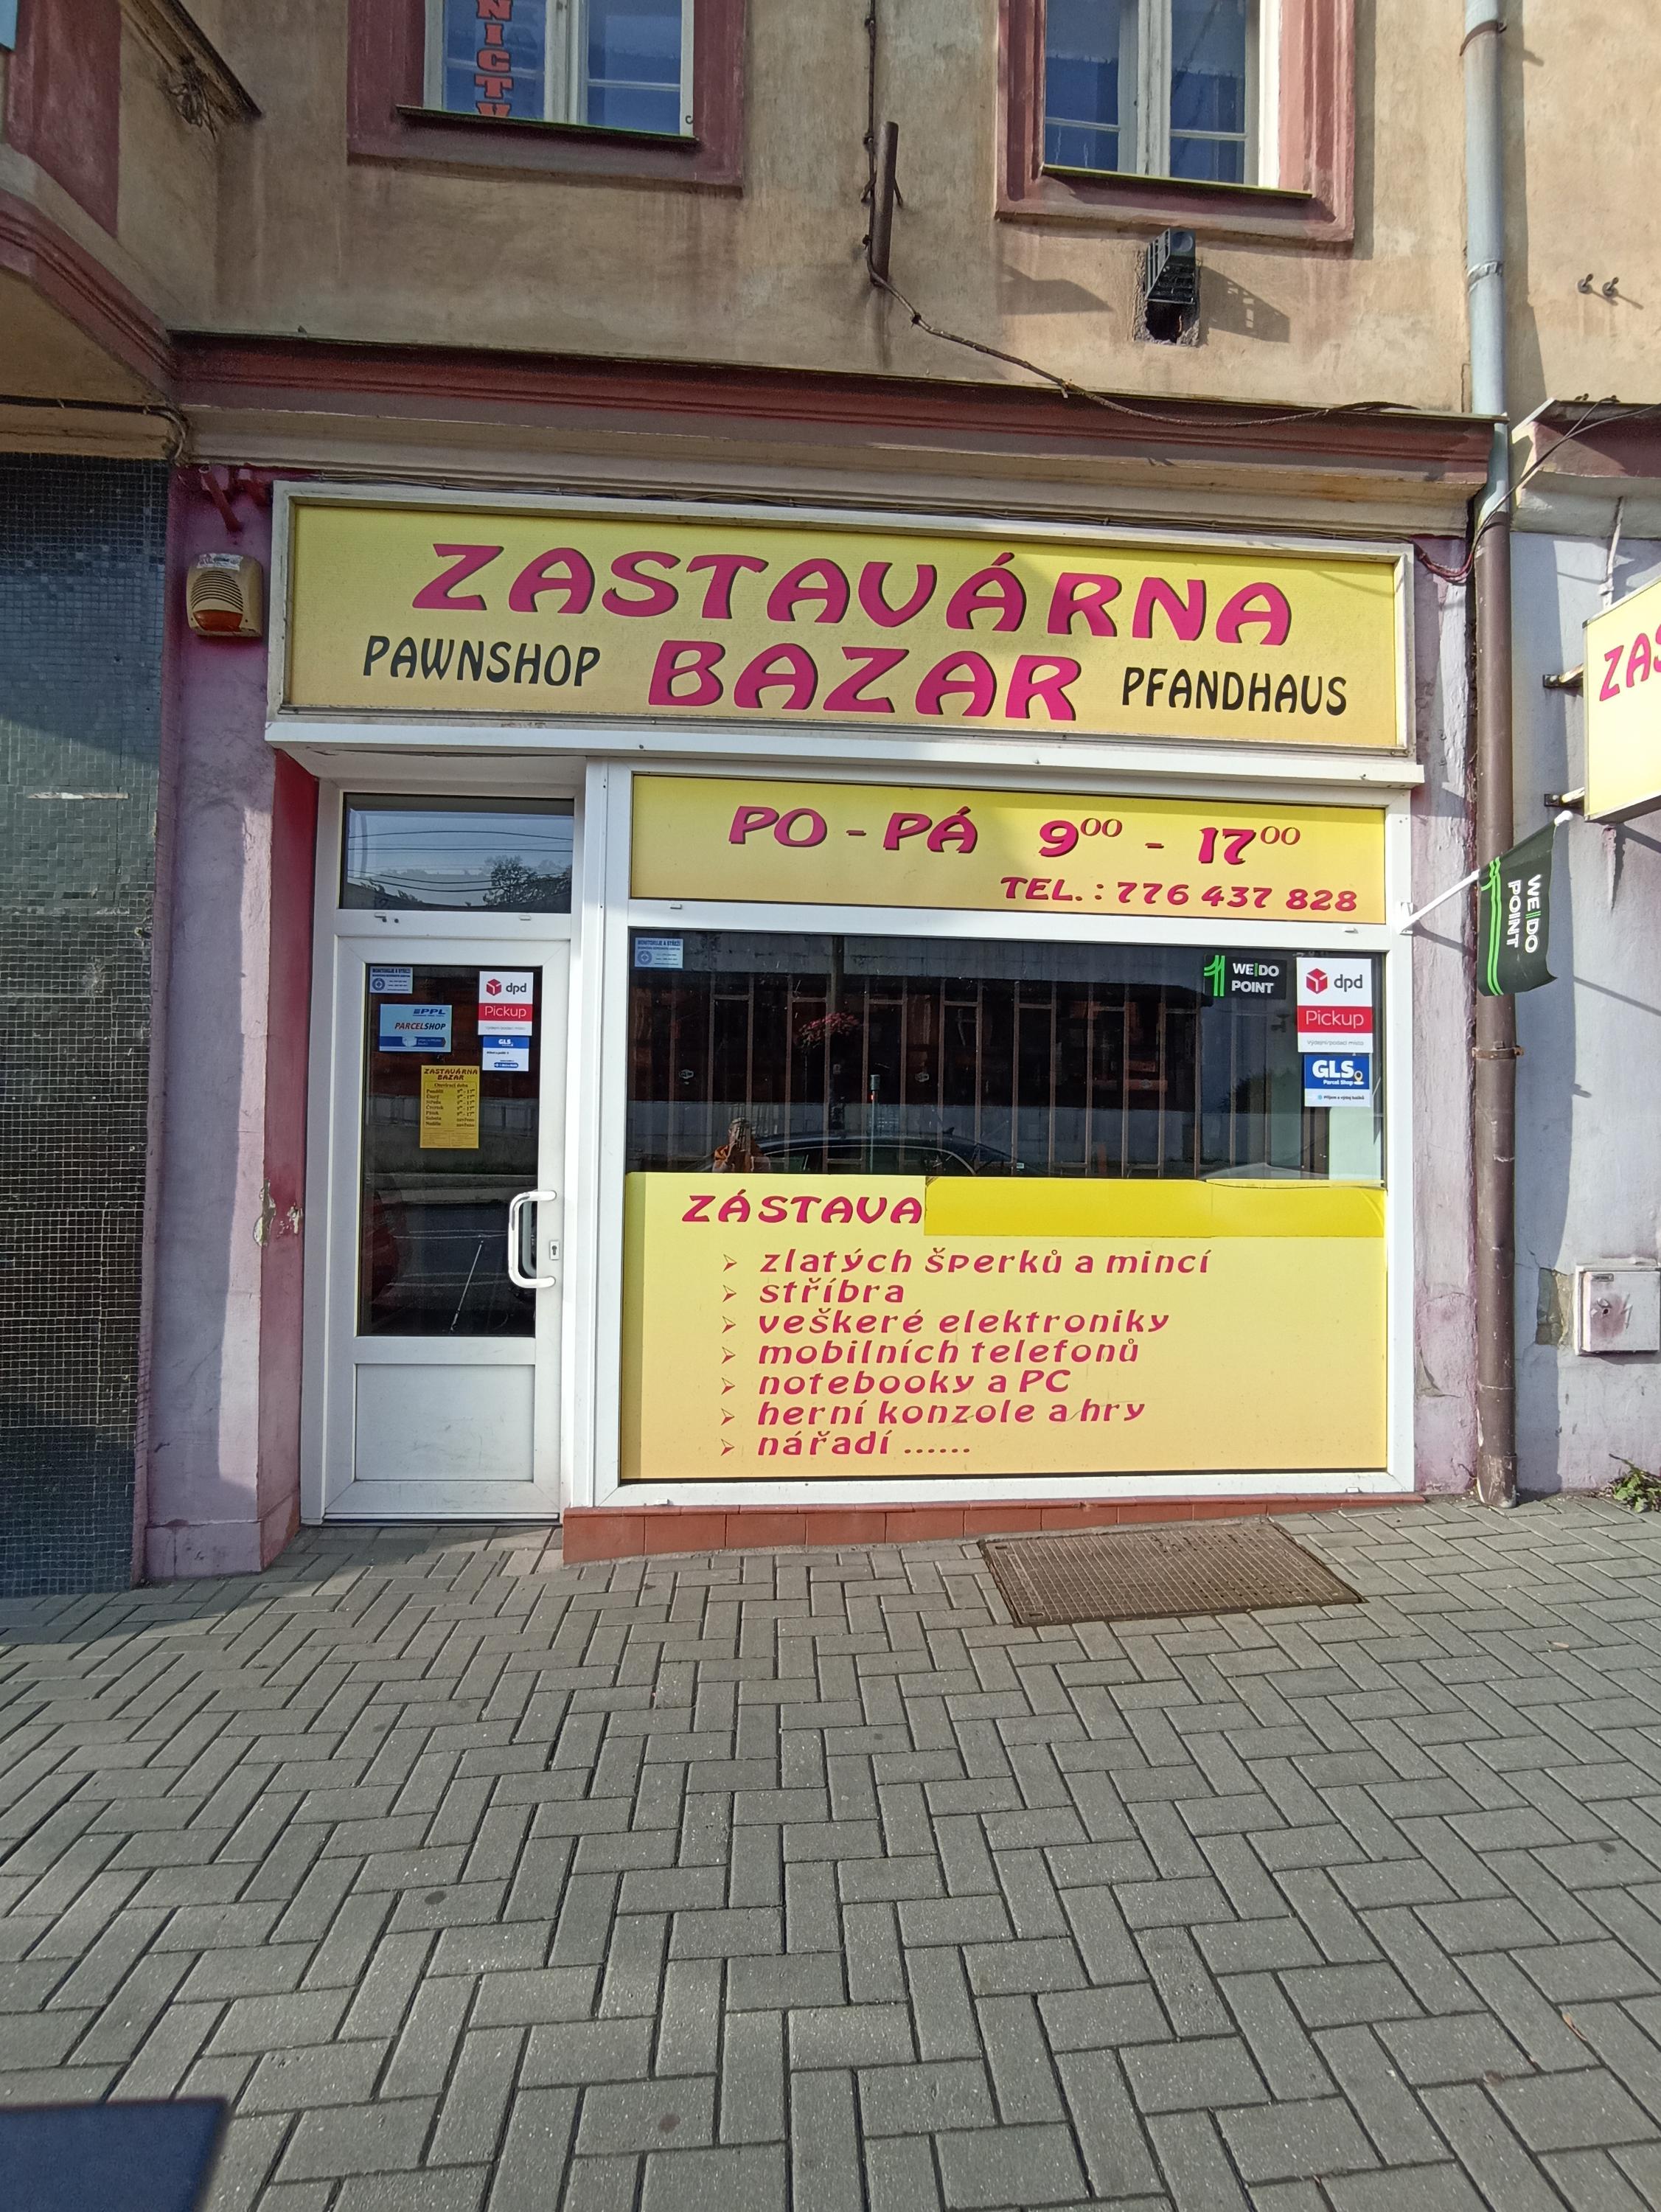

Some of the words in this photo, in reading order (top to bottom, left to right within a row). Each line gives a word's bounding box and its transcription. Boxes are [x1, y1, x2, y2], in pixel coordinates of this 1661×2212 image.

[411, 543, 1292, 647] ZASTAVÁRNA
[363, 635, 601, 687] PAWNSHOP
[648, 639, 1082, 721] BAZAR
[1122, 667, 1347, 716] PFANDHAUS
[728, 806, 827, 847] PO
[883, 807, 978, 853] PÁ
[1118, 882, 1188, 905] 776
[1202, 886, 1272, 909] 437
[1286, 888, 1357, 912] 828
[1507, 879, 1522, 948] POINT
[506, 983, 526, 995] dpd
[1231, 980, 1274, 993] POINT
[1334, 974, 1362, 992] dpd
[485, 1006, 526, 1018] Pickup
[1306, 1010, 1364, 1029] Pickup
[1312, 1060, 1354, 1078] GLS
[681, 1189, 922, 1225] ZÁSTAVA
[760, 1248, 913, 1274] zlatých
[924, 1248, 1062, 1274] šperků
[1075, 1256, 1094, 1274] a
[1107, 1249, 1211, 1274] mincí
[759, 1277, 904, 1304] stříbra
[759, 1308, 924, 1335] veškeré
[939, 1309, 1169, 1334] elektroniky
[758, 1339, 959, 1365] mobilních
[972, 1338, 1139, 1364] telefonů
[758, 1370, 974, 1395] notebooky
[987, 1375, 1007, 1394] a
[1019, 1369, 1071, 1393] PC
[757, 1399, 868, 1425] herní
[878, 1399, 1035, 1425] konzole
[1048, 1404, 1068, 1424] a
[1080, 1399, 1146, 1422] hry
[757, 1429, 894, 1456] nářadí
